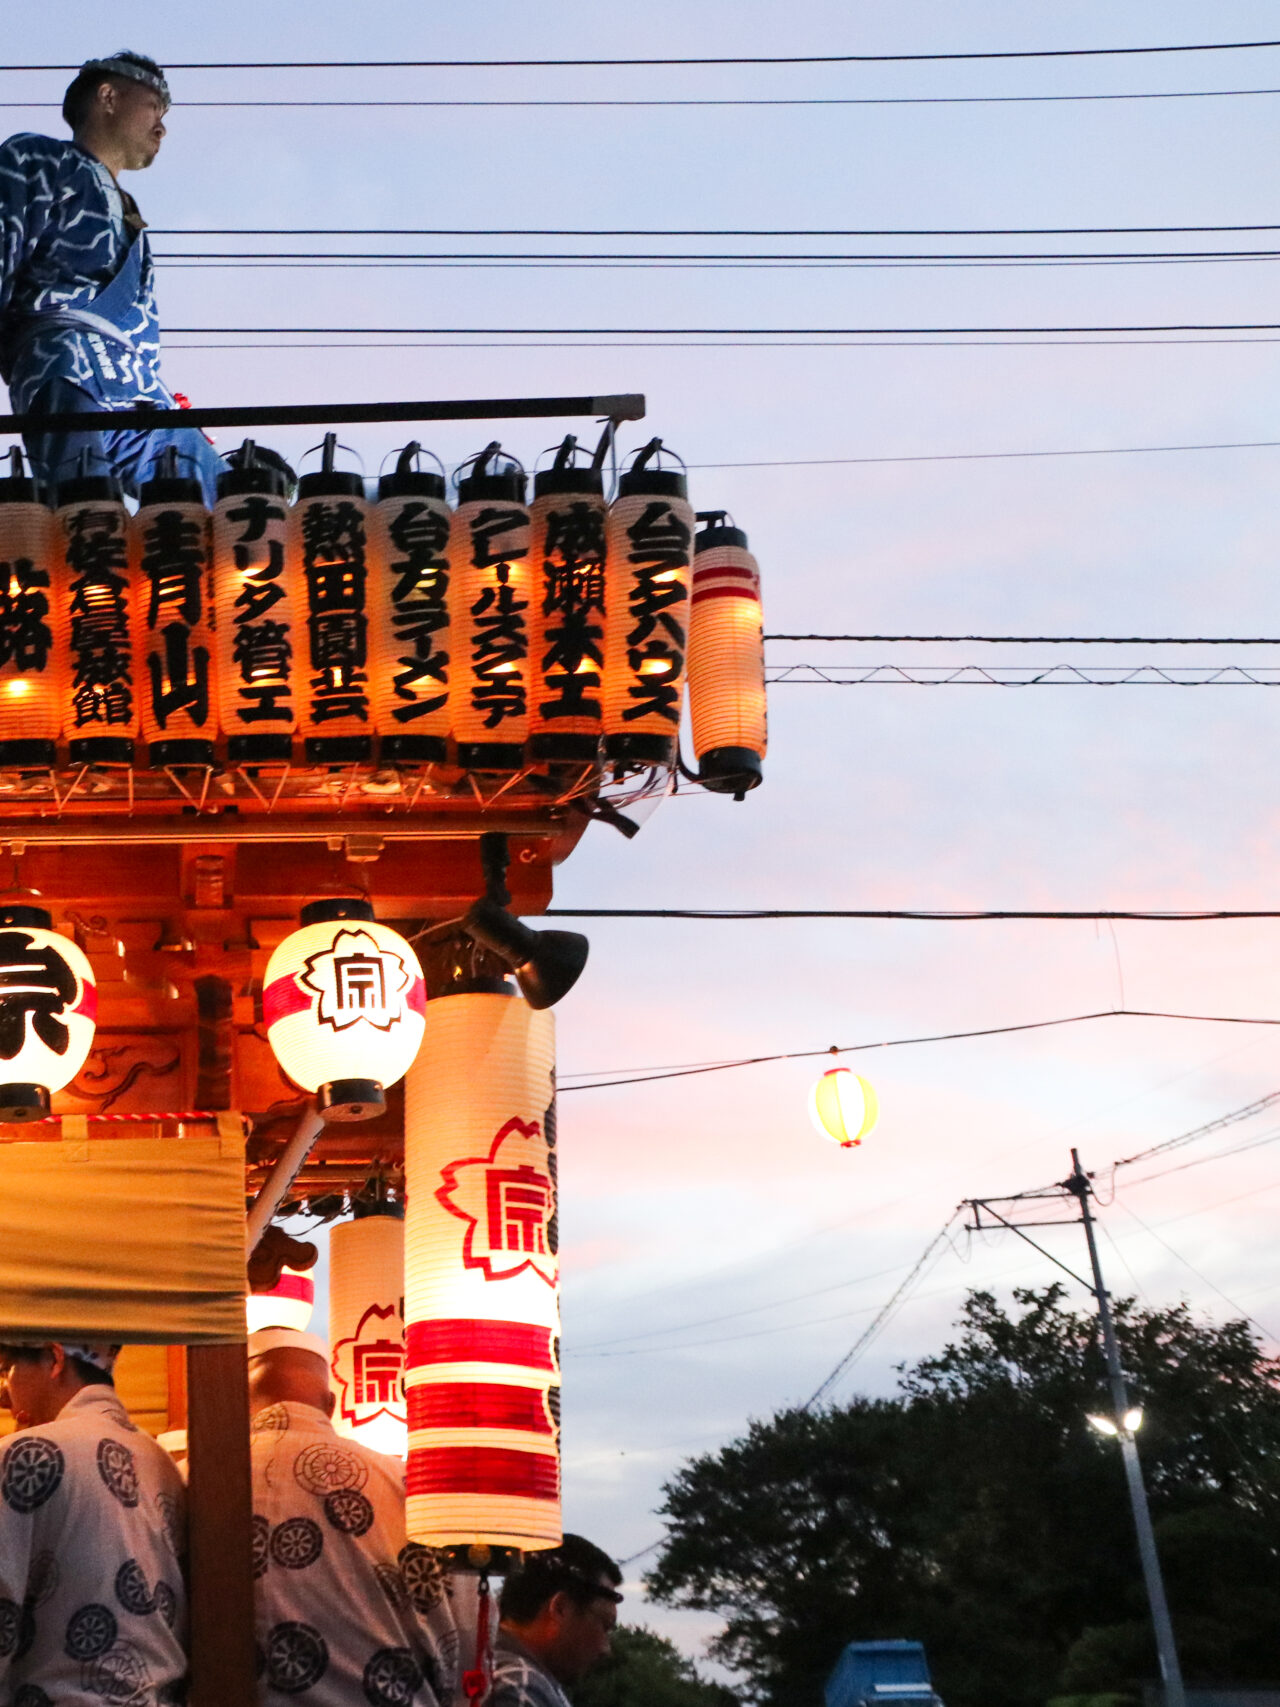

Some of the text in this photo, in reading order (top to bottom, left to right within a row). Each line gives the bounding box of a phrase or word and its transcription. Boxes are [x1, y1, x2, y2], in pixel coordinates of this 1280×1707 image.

[141, 510, 210, 730] 青山
[226, 496, 293, 724] ナリタ管工
[302, 500, 369, 724] 熱田園芸
[389, 502, 449, 723] 台方ラーメン
[469, 507, 530, 729] クレールスクエア
